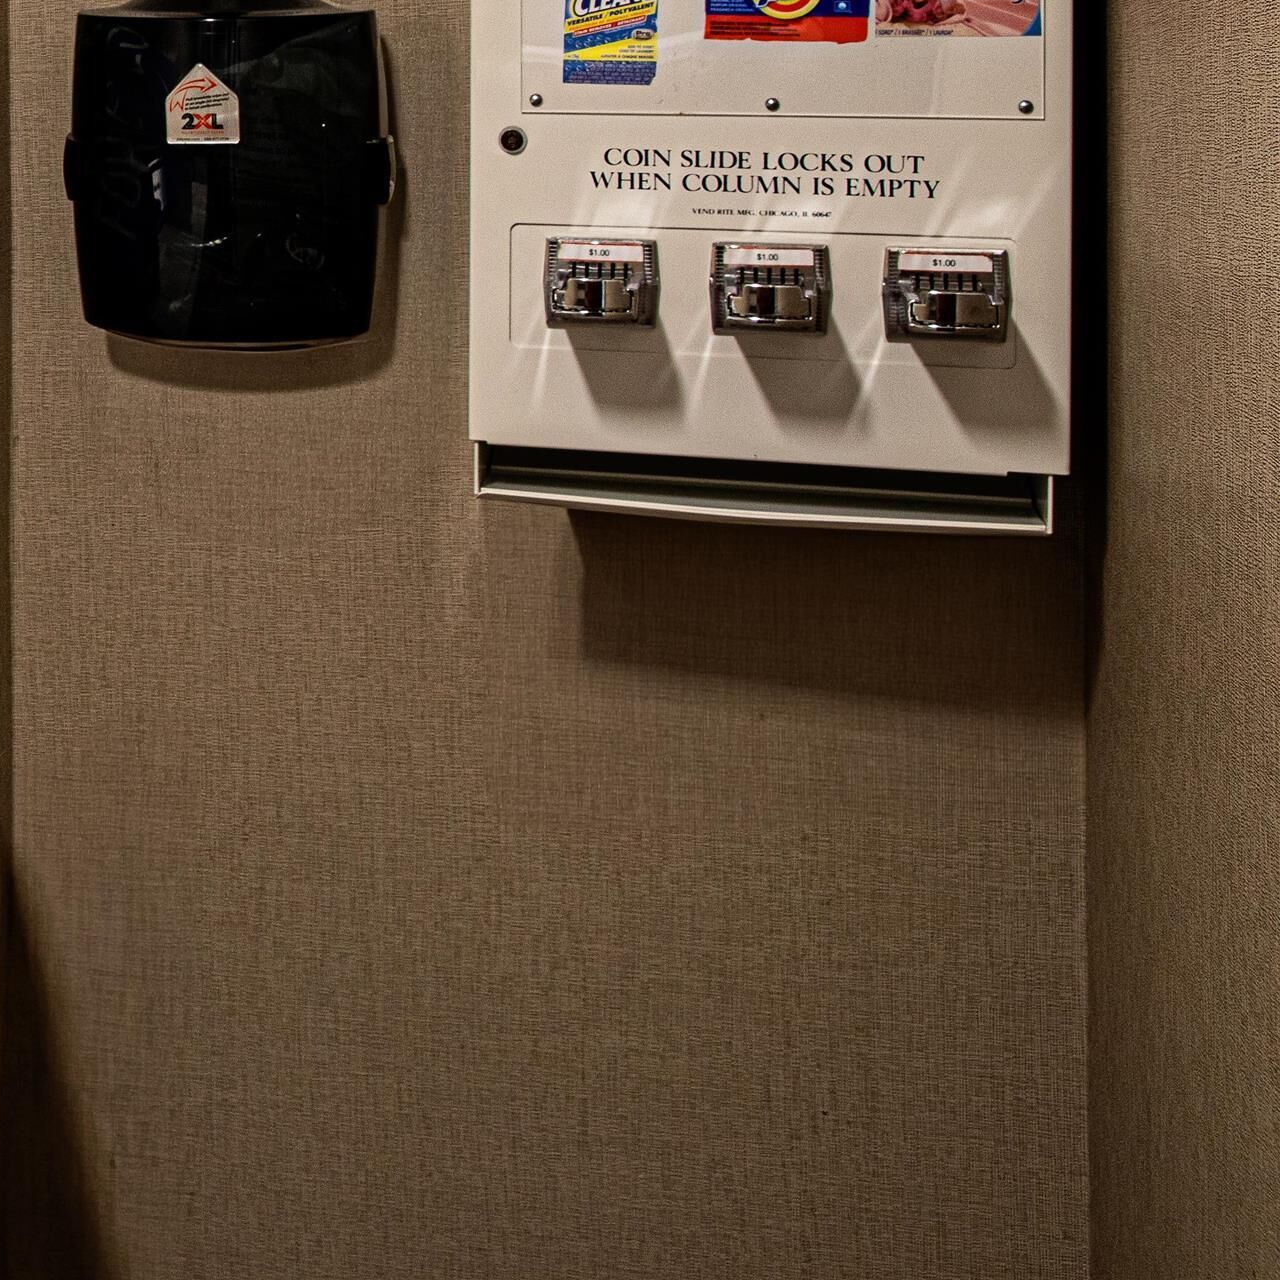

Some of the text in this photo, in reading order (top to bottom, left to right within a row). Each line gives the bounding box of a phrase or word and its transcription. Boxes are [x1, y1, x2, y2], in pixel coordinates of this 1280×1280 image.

[181, 113, 224, 130] 2XL
[603, 148, 925, 174] COIN SLIDE LOCKS OUT
[590, 171, 940, 199] WHEN COLUMN IS EMPTY
[589, 249, 610, 257] $1.00
[757, 253, 779, 261] $1.00
[933, 259, 956, 267] $1.00
